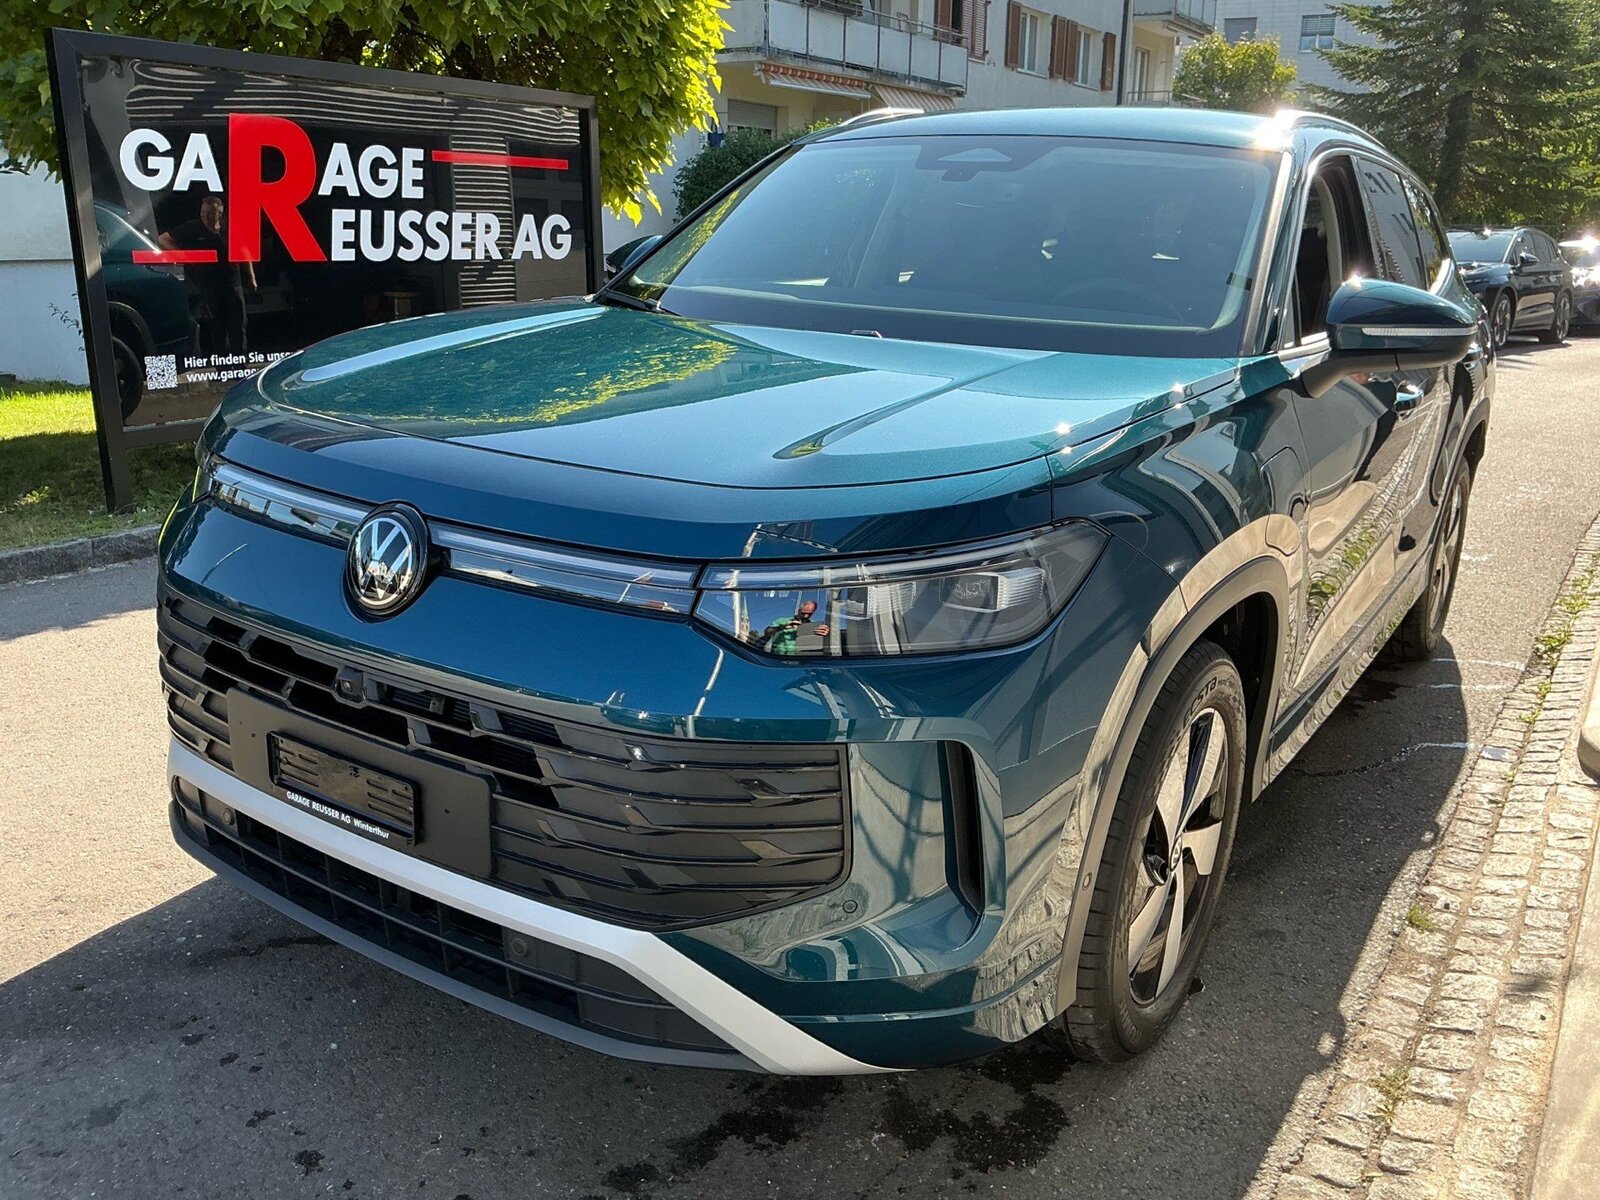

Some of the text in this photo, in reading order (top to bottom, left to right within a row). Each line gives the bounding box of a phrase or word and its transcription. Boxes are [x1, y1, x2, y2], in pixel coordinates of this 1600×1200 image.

[119, 113, 425, 263] GARAGE
[512, 214, 572, 260] AG
[184, 356, 207, 368] Hier
[210, 353, 246, 365] finden
[248, 352, 265, 363] Sie
[286, 791, 390, 839] GARAGE REUSSER AG Winterthur
